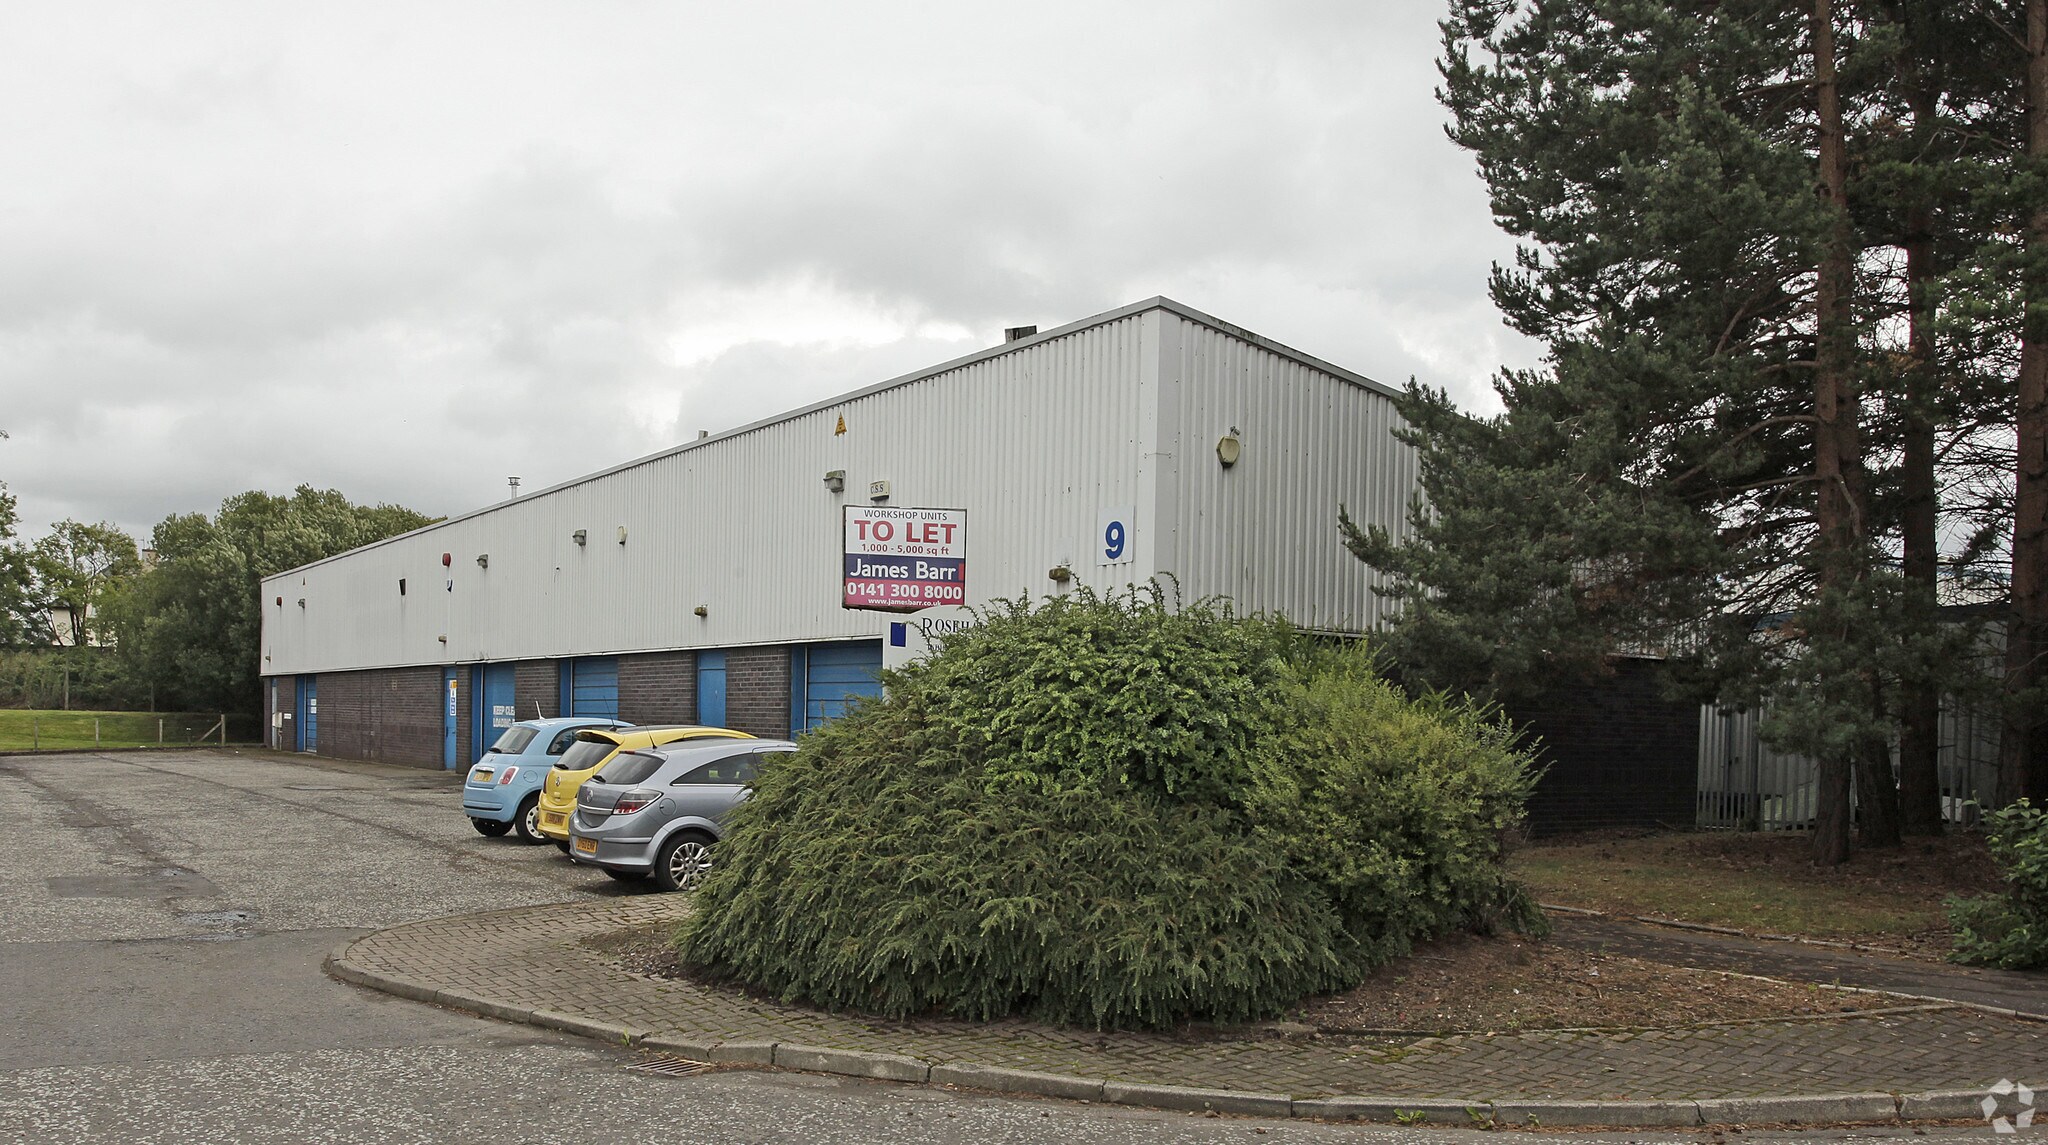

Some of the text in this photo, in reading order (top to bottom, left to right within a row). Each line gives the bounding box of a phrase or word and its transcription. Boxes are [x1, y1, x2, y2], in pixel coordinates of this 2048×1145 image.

[864, 509, 948, 521] WORKSHOP UNITS
[854, 520, 957, 544] TO LET
[1105, 521, 1125, 560] 9
[862, 543, 888, 552] 1,000
[897, 545, 924, 554] 5,000
[926, 547, 938, 556] sq
[940, 546, 949, 555] ft
[850, 558, 957, 580] James Barr
[847, 582, 963, 599] 0141 300 8000
[868, 598, 941, 606] www.jamesbarr.co.uk
